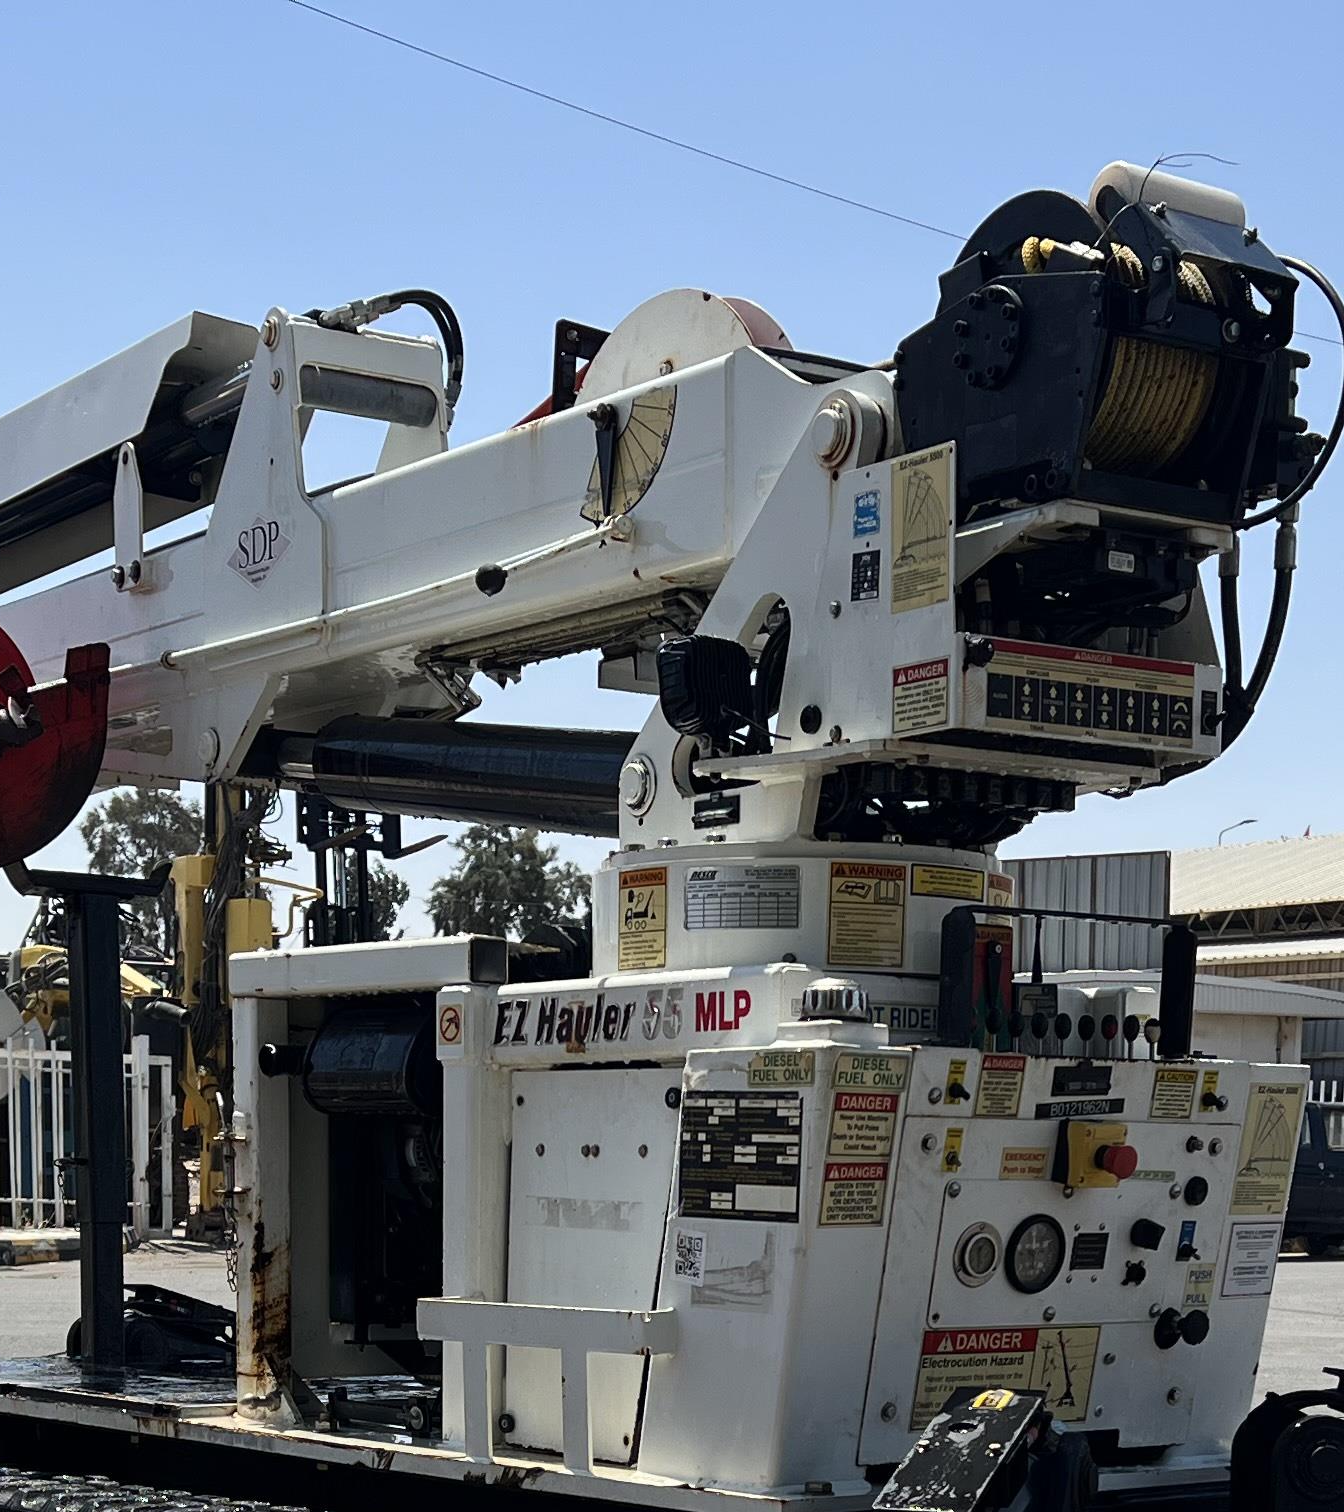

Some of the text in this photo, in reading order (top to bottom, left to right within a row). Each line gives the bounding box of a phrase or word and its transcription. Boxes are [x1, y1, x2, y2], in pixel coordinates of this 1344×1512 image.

[1081, 653, 1113, 665] DANGER
[907, 663, 944, 681] DANGER
[628, 871, 663, 884] WARNING
[847, 865, 904, 879] WARNING
[493, 999, 530, 1046] EZ
[536, 993, 637, 1046] Hauler
[695, 989, 752, 1033] MLP
[890, 1006, 937, 1029] RIDE!
[763, 1054, 800, 1068] DIESEL
[851, 1057, 892, 1072] DIESEL
[991, 1058, 1024, 1069] DANGER
[752, 1068, 811, 1082] FUEL ONLY
[837, 1071, 904, 1086] FUEL ONLY
[1166, 1072, 1194, 1081] CAUTION
[841, 1095, 892, 1111] DANGER
[1050, 1100, 1110, 1117] B0121962N
[1005, 1152, 1047, 1162] EMERGENCY
[840, 1166, 884, 1179] DANGER
[1003, 1166, 1018, 1174] Push
[1189, 1269, 1213, 1281] PUSH
[1185, 1293, 1207, 1304] PULL
[956, 1332, 1023, 1350] DANGER
[921, 1354, 1025, 1369] Electrocution Hazard
[925, 1374, 944, 1383] Never
